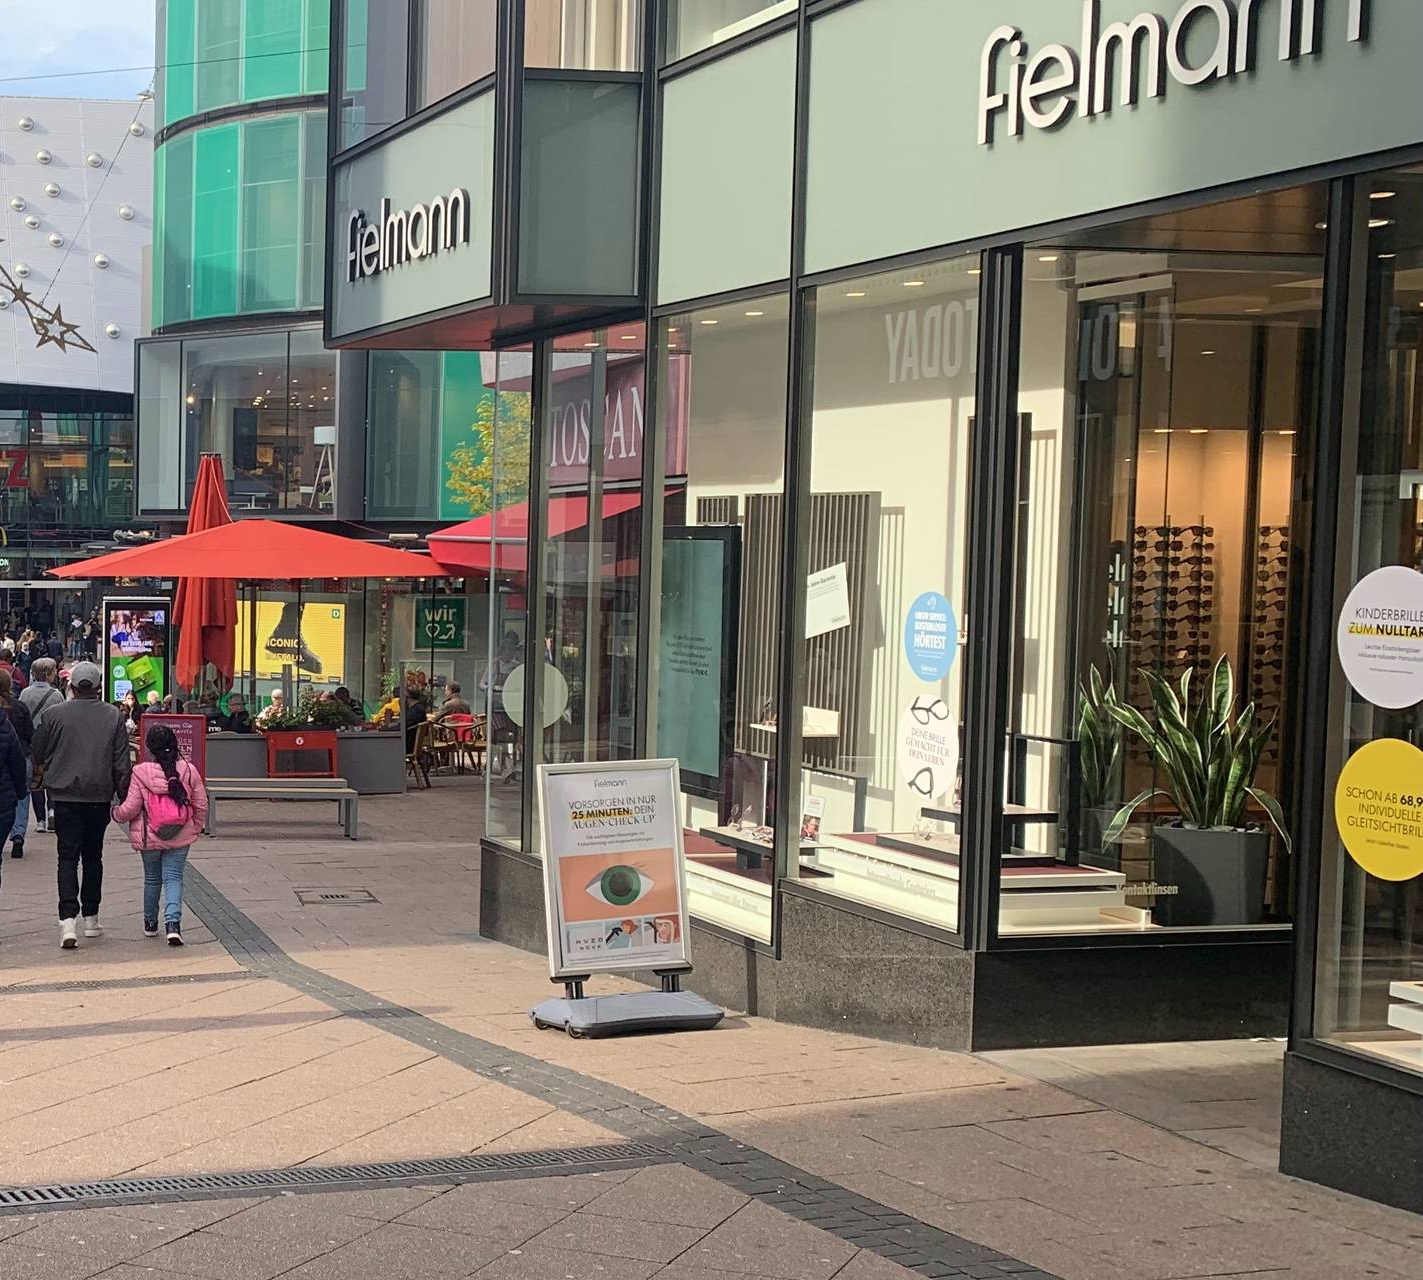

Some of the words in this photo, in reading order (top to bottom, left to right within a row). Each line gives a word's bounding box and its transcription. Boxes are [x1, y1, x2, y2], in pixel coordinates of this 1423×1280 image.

[347, 187, 470, 283] fielmann
[550, 387, 644, 467] TOSAN
[424, 604, 457, 621] wir
[1349, 622, 1374, 635] ZUM
[914, 631, 947, 649] HÖRTEST
[569, 797, 624, 810] VORSORGEN
[625, 796, 636, 806] IN
[638, 794, 656, 805] NUR
[1346, 786, 1382, 801] SCHON
[1385, 793, 1398, 804] AB
[572, 811, 584, 820] 25
[586, 807, 633, 819] MINUTEN:
[634, 805, 655, 815] DEIN
[1358, 803, 1421, 823] INDIVIDUELLE
